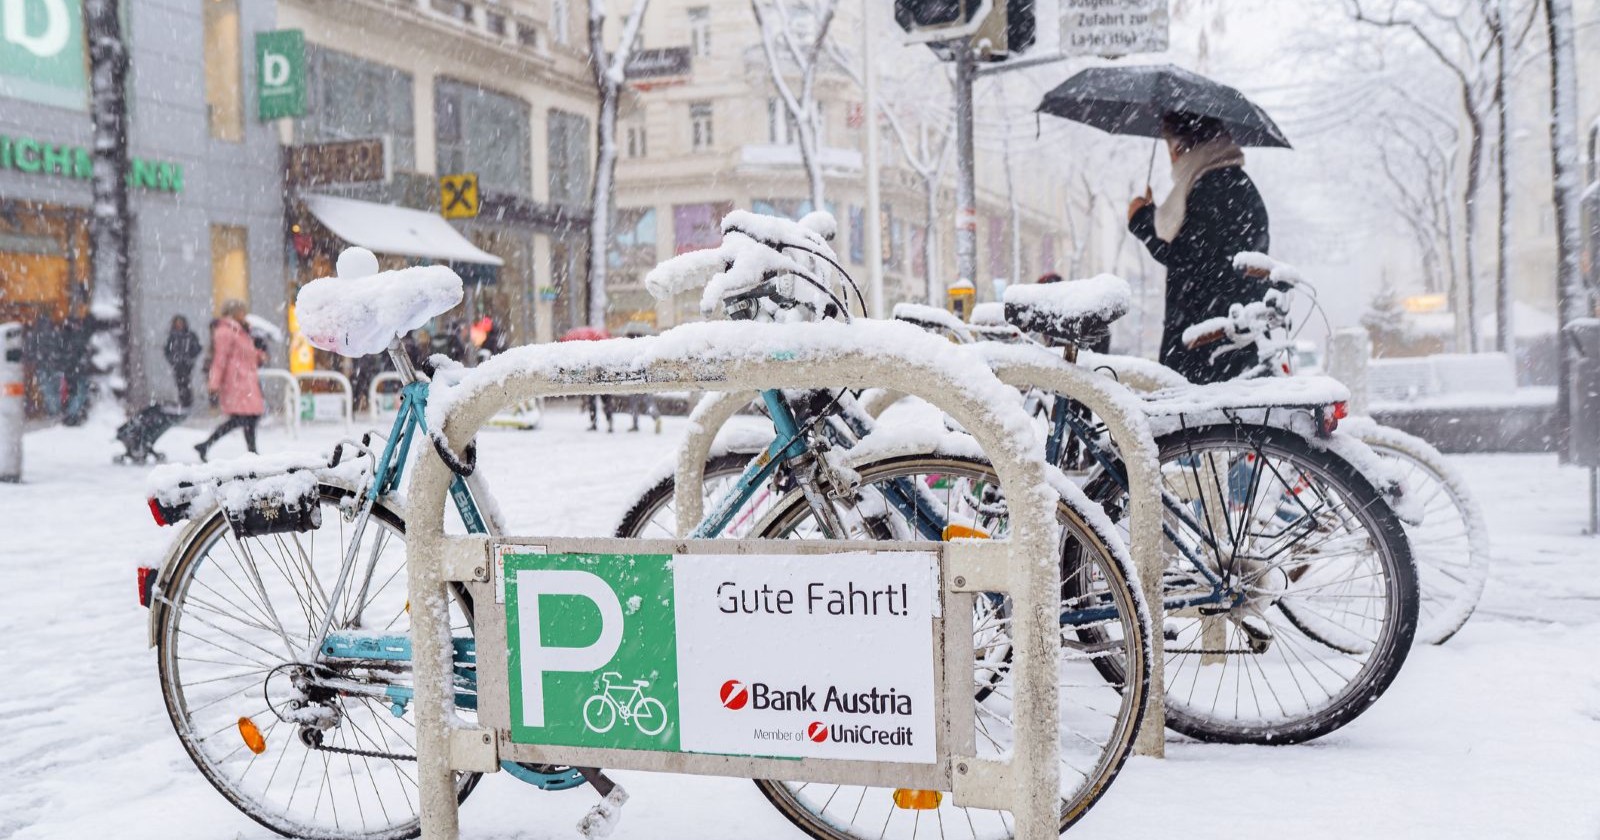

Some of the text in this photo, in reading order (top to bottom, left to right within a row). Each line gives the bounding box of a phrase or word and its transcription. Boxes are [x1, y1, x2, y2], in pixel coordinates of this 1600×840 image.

[263, 51, 291, 86] b
[717, 582, 908, 616] Gute Fahrt!
[516, 570, 624, 728] P
[752, 683, 913, 715] Bank Austria
[753, 724, 913, 746] Member of UniCredit
